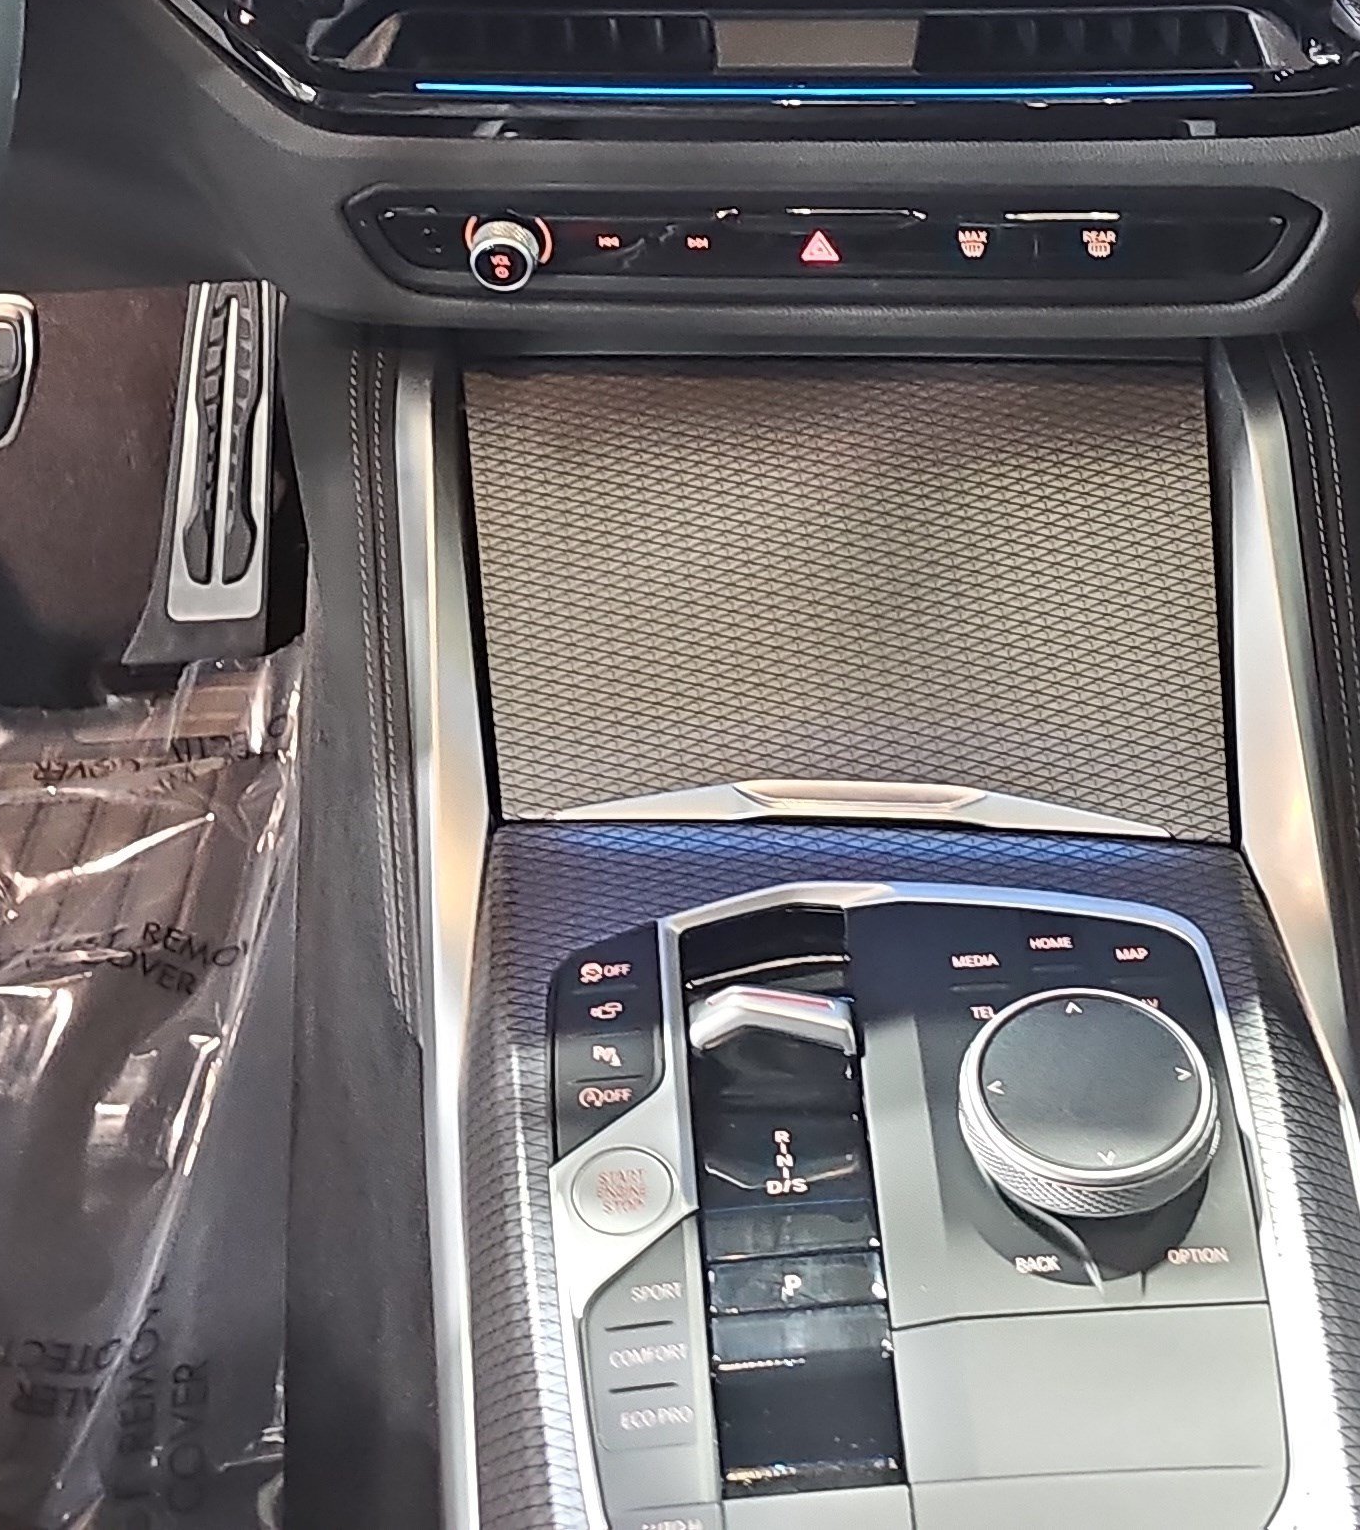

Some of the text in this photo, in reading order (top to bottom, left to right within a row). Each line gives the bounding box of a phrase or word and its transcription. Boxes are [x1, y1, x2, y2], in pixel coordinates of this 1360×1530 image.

[1029, 935, 1075, 950] HOME
[951, 953, 1000, 969] MEDIA
[1115, 946, 1150, 962] MAP
[603, 962, 633, 978] OFF
[602, 1087, 633, 1104] OFF
[1014, 1255, 1062, 1274] BACK
[1166, 1246, 1230, 1265] OPTION
[630, 1281, 683, 1303] SPORT
[608, 1342, 689, 1369] COMFORT
[619, 1408, 655, 1431] ECO
